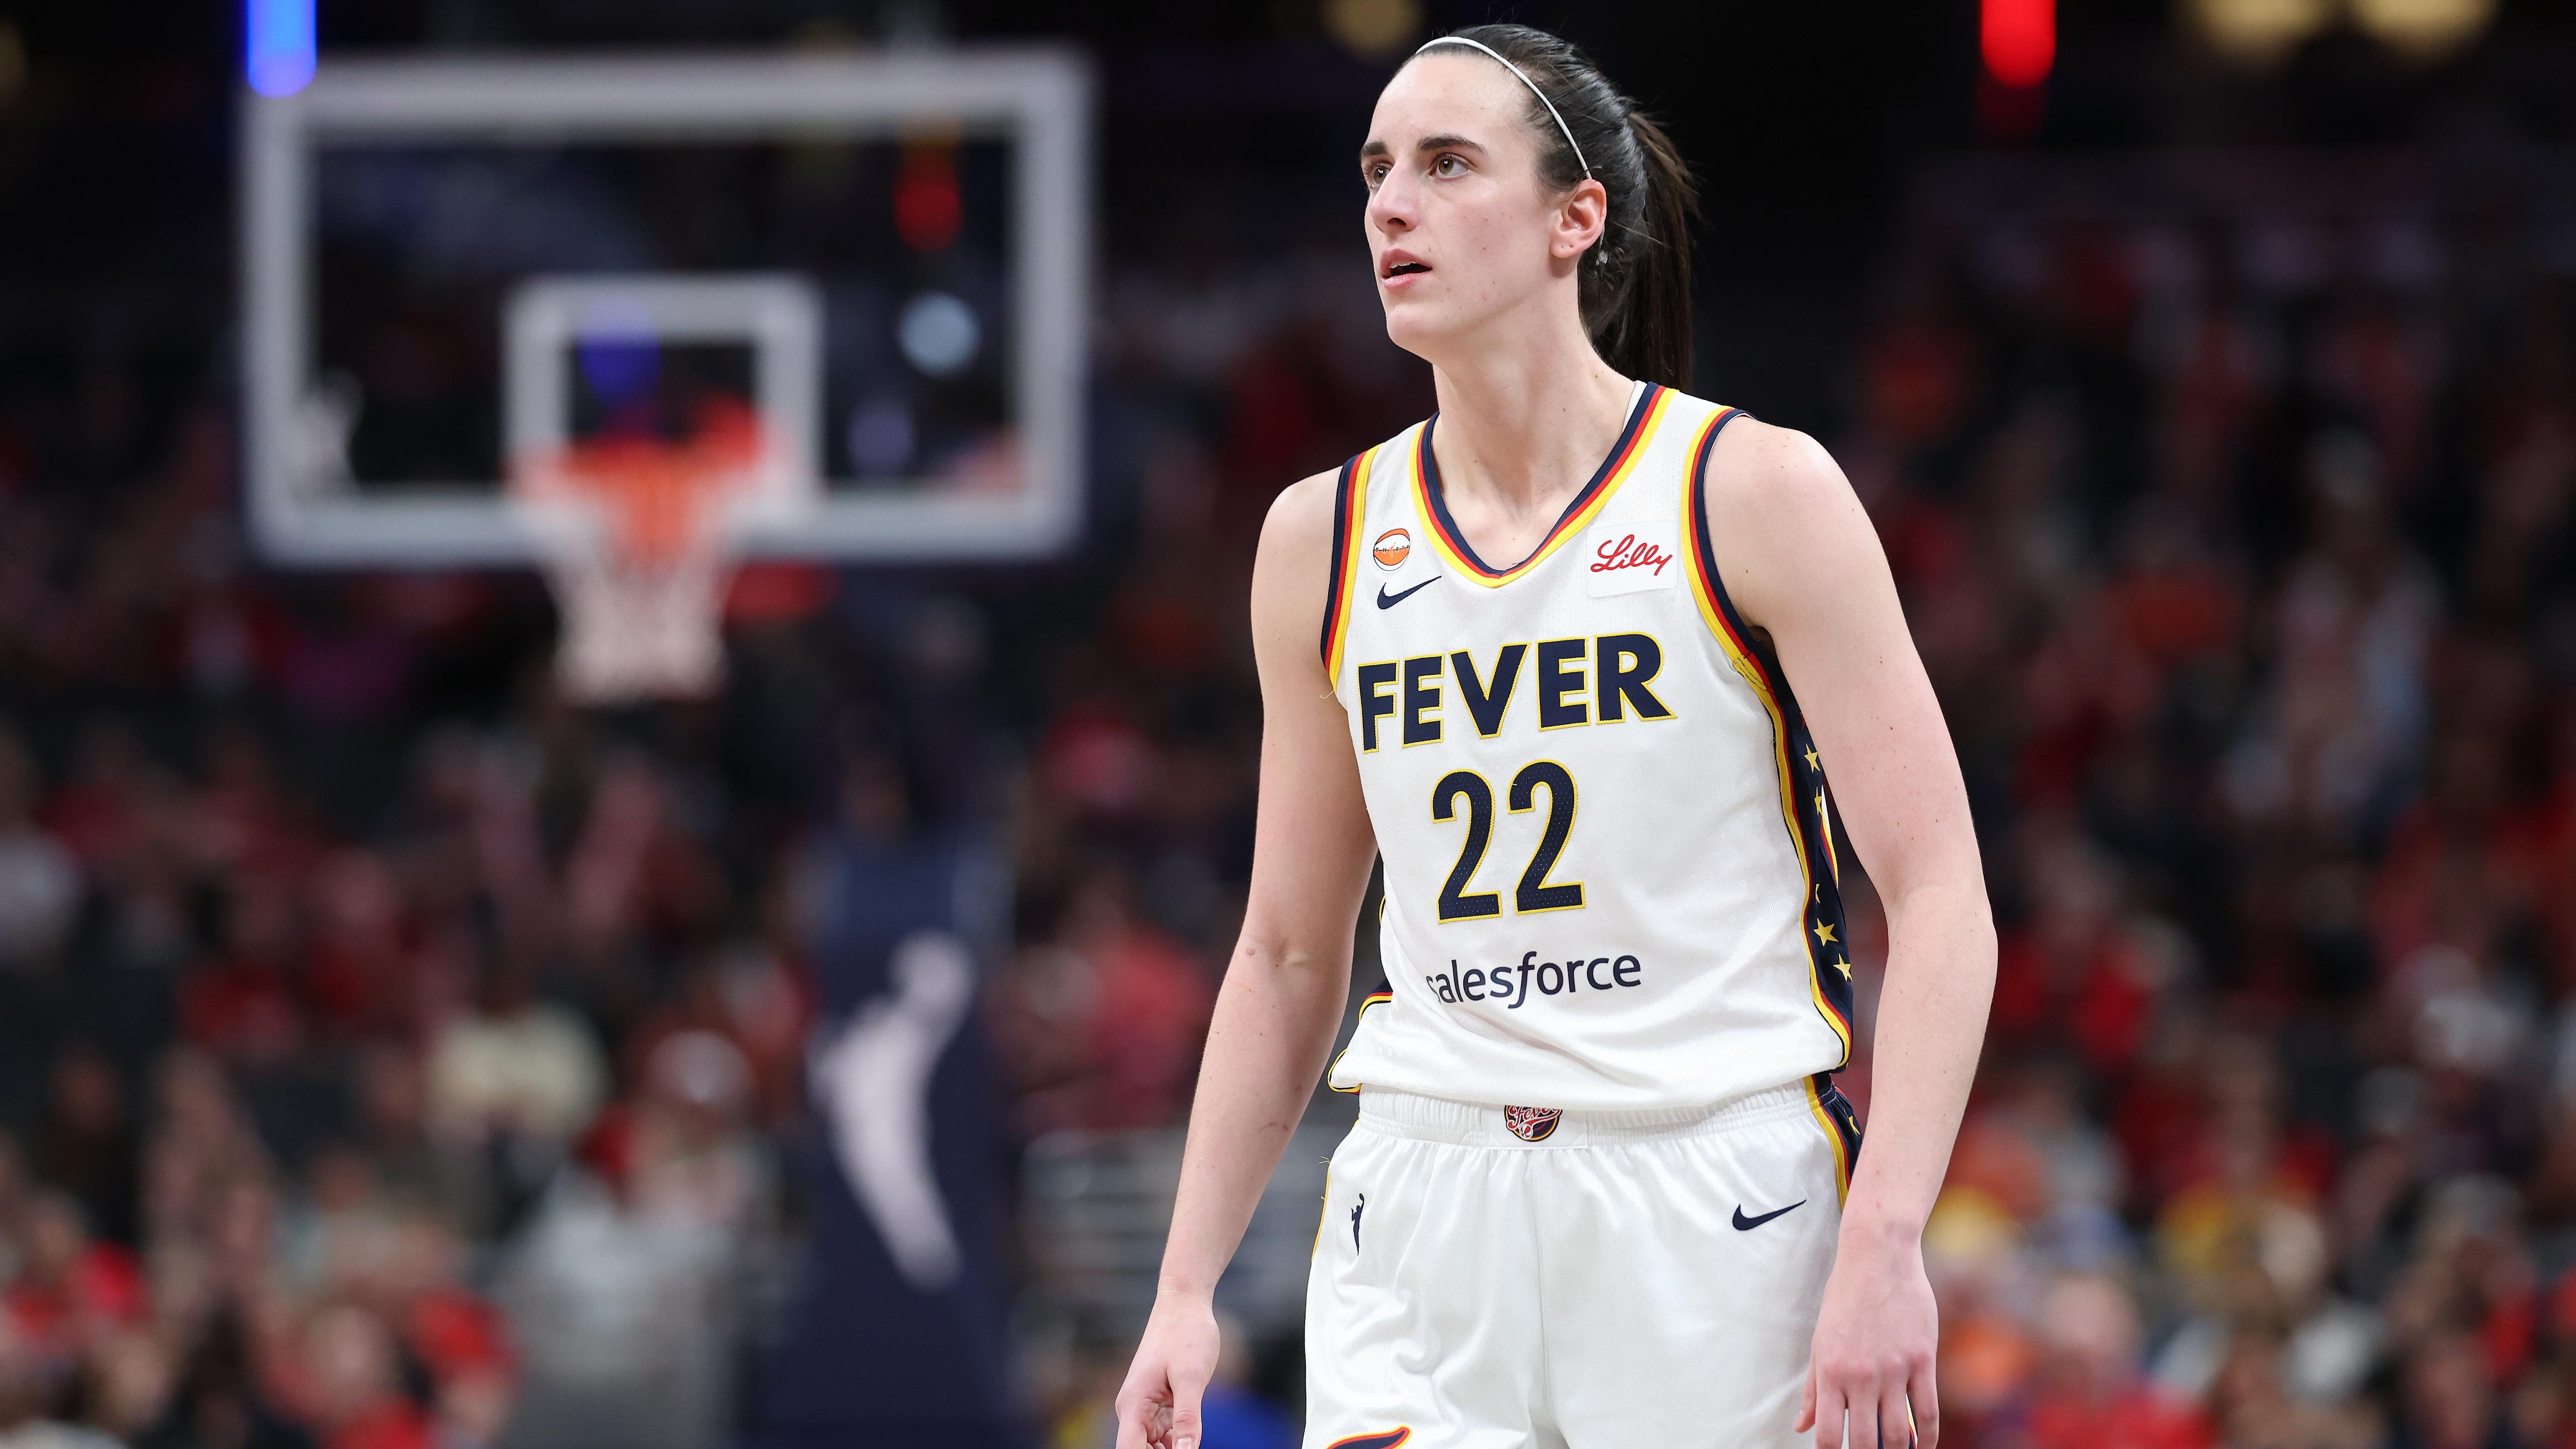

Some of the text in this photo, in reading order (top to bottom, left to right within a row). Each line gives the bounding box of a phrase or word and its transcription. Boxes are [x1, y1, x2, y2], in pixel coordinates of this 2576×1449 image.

[1590, 534, 1673, 576] Lilly
[1357, 632, 1677, 754] FEVER
[1431, 758, 1586, 923] 22
[1426, 951, 1641, 1009] salesforce
